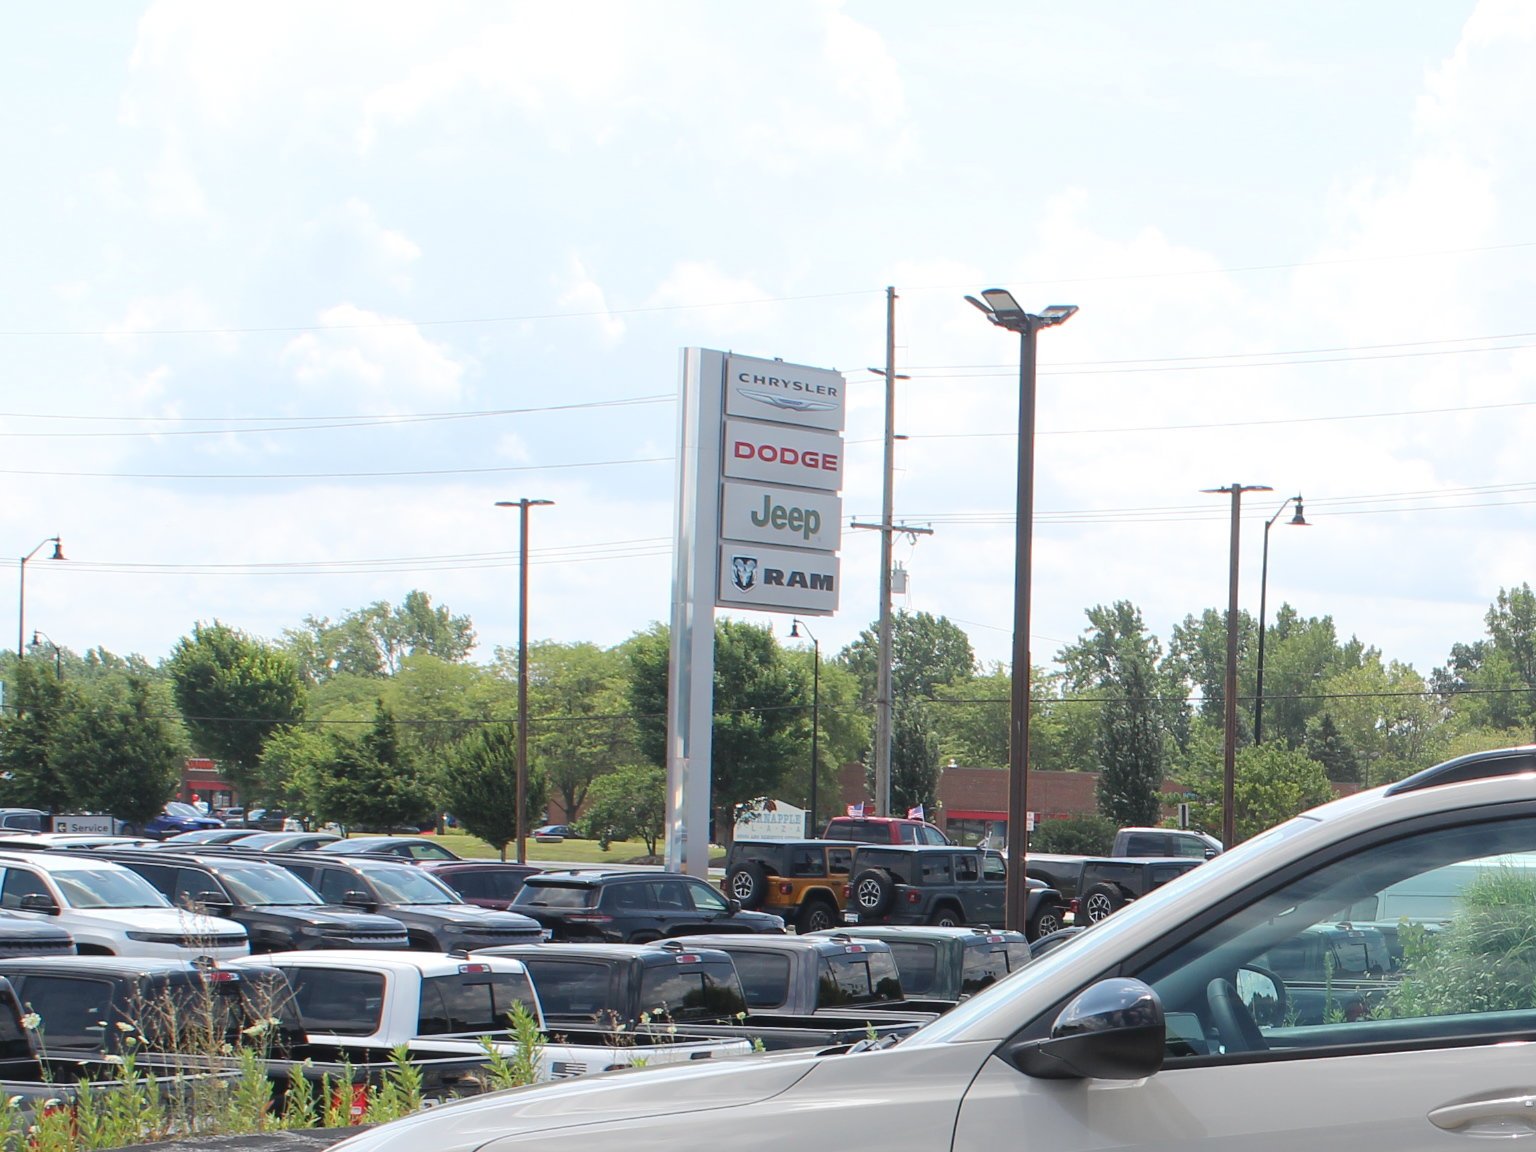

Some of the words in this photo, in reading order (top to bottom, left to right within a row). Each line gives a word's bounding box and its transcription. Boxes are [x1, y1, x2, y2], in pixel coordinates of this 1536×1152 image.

[739, 373, 838, 397] CHRYSLER
[734, 441, 838, 471] DODGE
[751, 495, 821, 539] Jeep
[764, 568, 835, 592] RAM
[72, 823, 109, 832] Service
